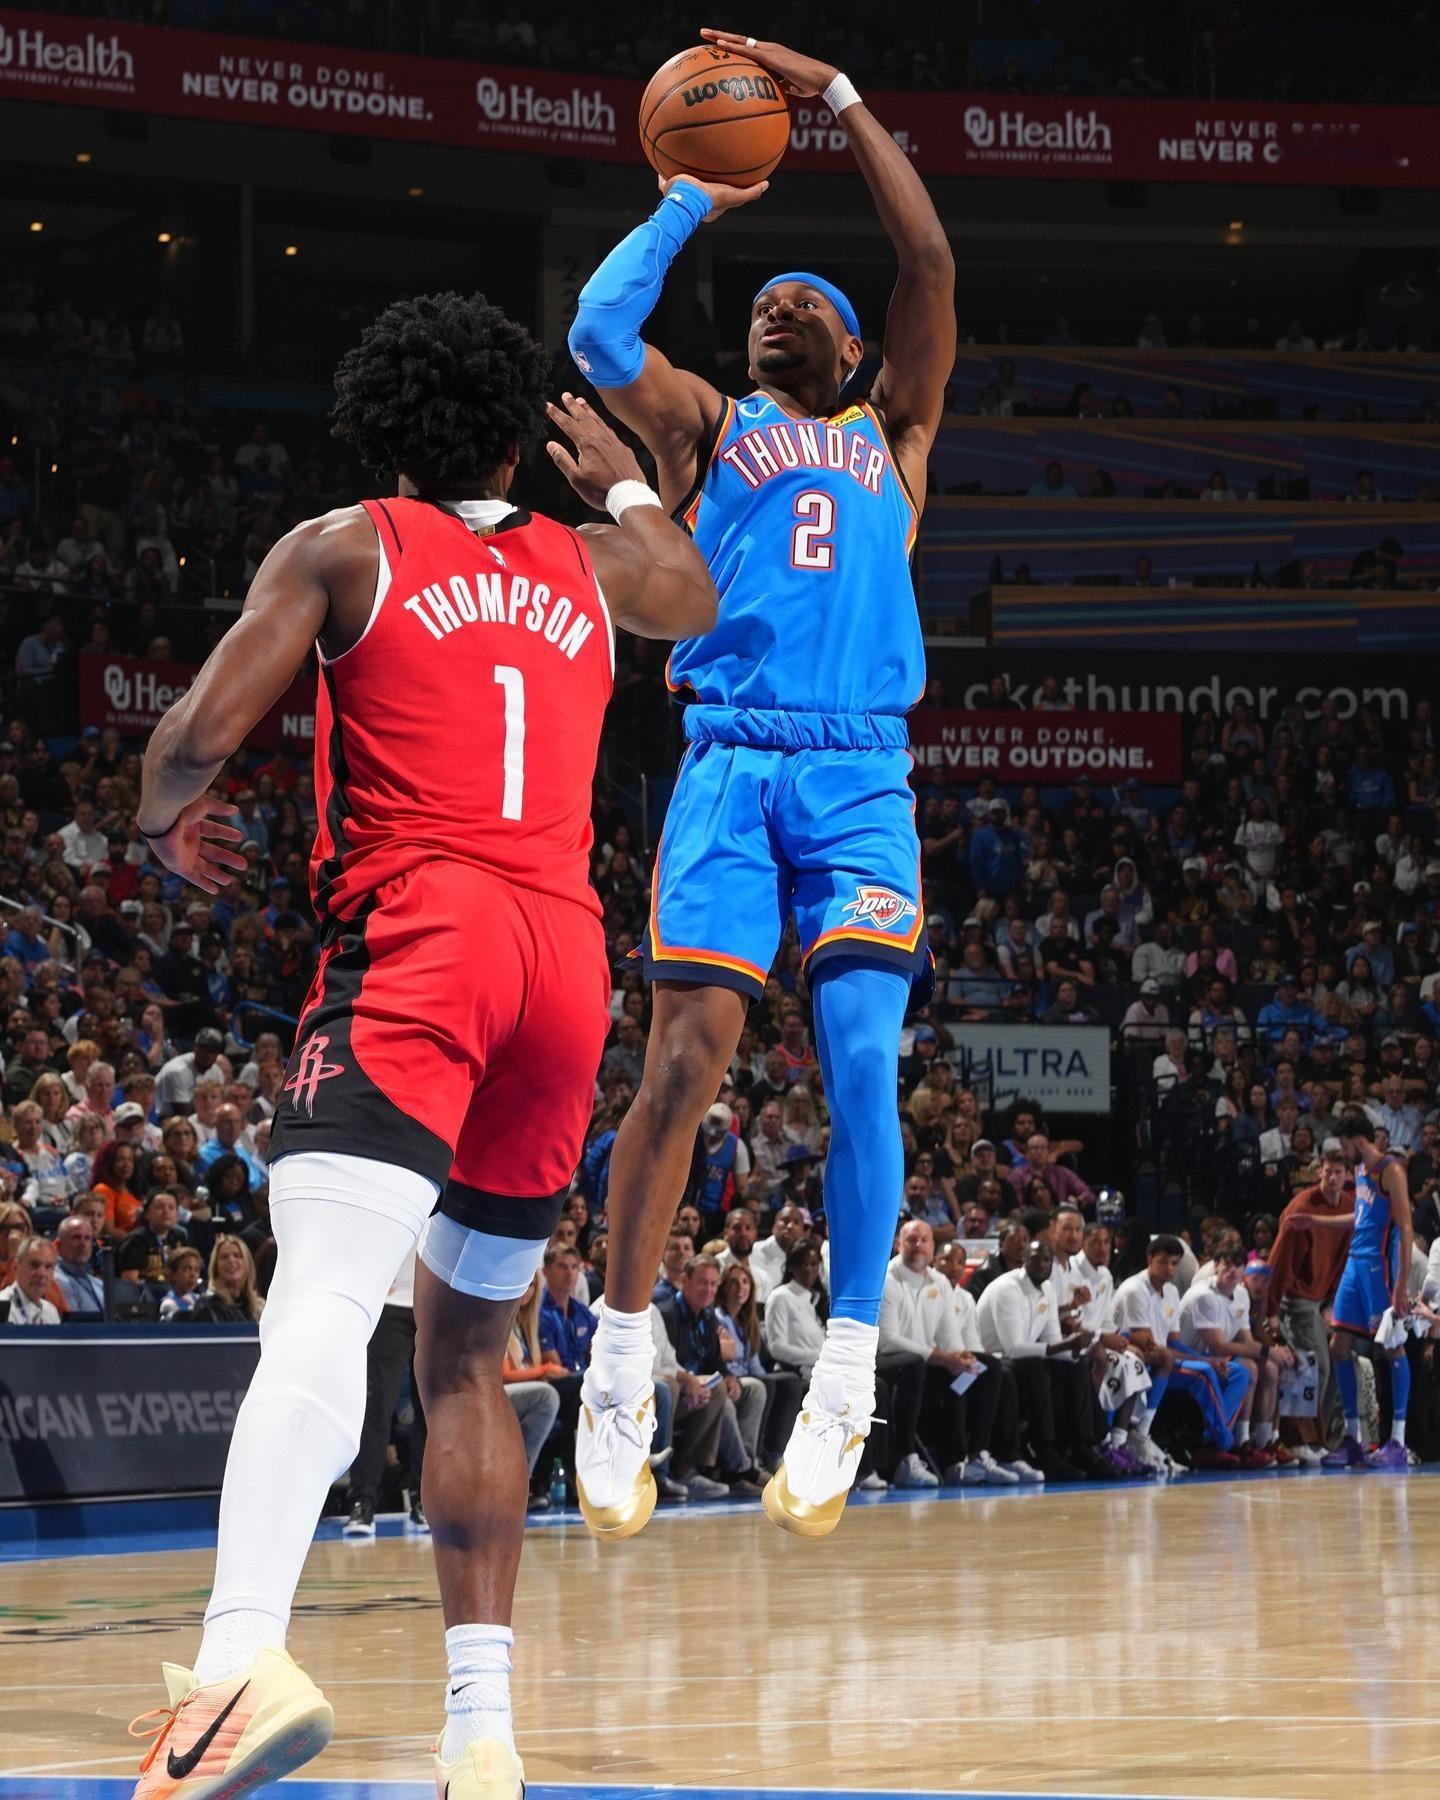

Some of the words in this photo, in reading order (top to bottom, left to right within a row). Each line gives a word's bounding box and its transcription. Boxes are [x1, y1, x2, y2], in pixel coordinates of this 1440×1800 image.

[19, 29, 134, 79] Health
[220, 55, 303, 80] NEVER
[317, 66, 394, 91] DONE.
[182, 71, 278, 104] NEVER
[288, 85, 434, 121] OUTDONE.
[510, 84, 616, 132] Health
[681, 75, 780, 107] Wilson
[1000, 110, 1112, 150] Health
[1195, 120, 1278, 139] NEVER
[1158, 138, 1254, 163] NEVER
[720, 422, 886, 496] THUNDER
[790, 489, 837, 572] 2
[402, 573, 595, 661] THOMPSON
[493, 665, 526, 821] 1
[942, 727, 1025, 744] NEVER
[1038, 727, 1116, 746] DONE.
[909, 746, 1000, 768] NEVER
[1009, 746, 1154, 769] OUTDONE.
[856, 897, 897, 915] OKC
[967, 1047, 1089, 1078] ULTRA
